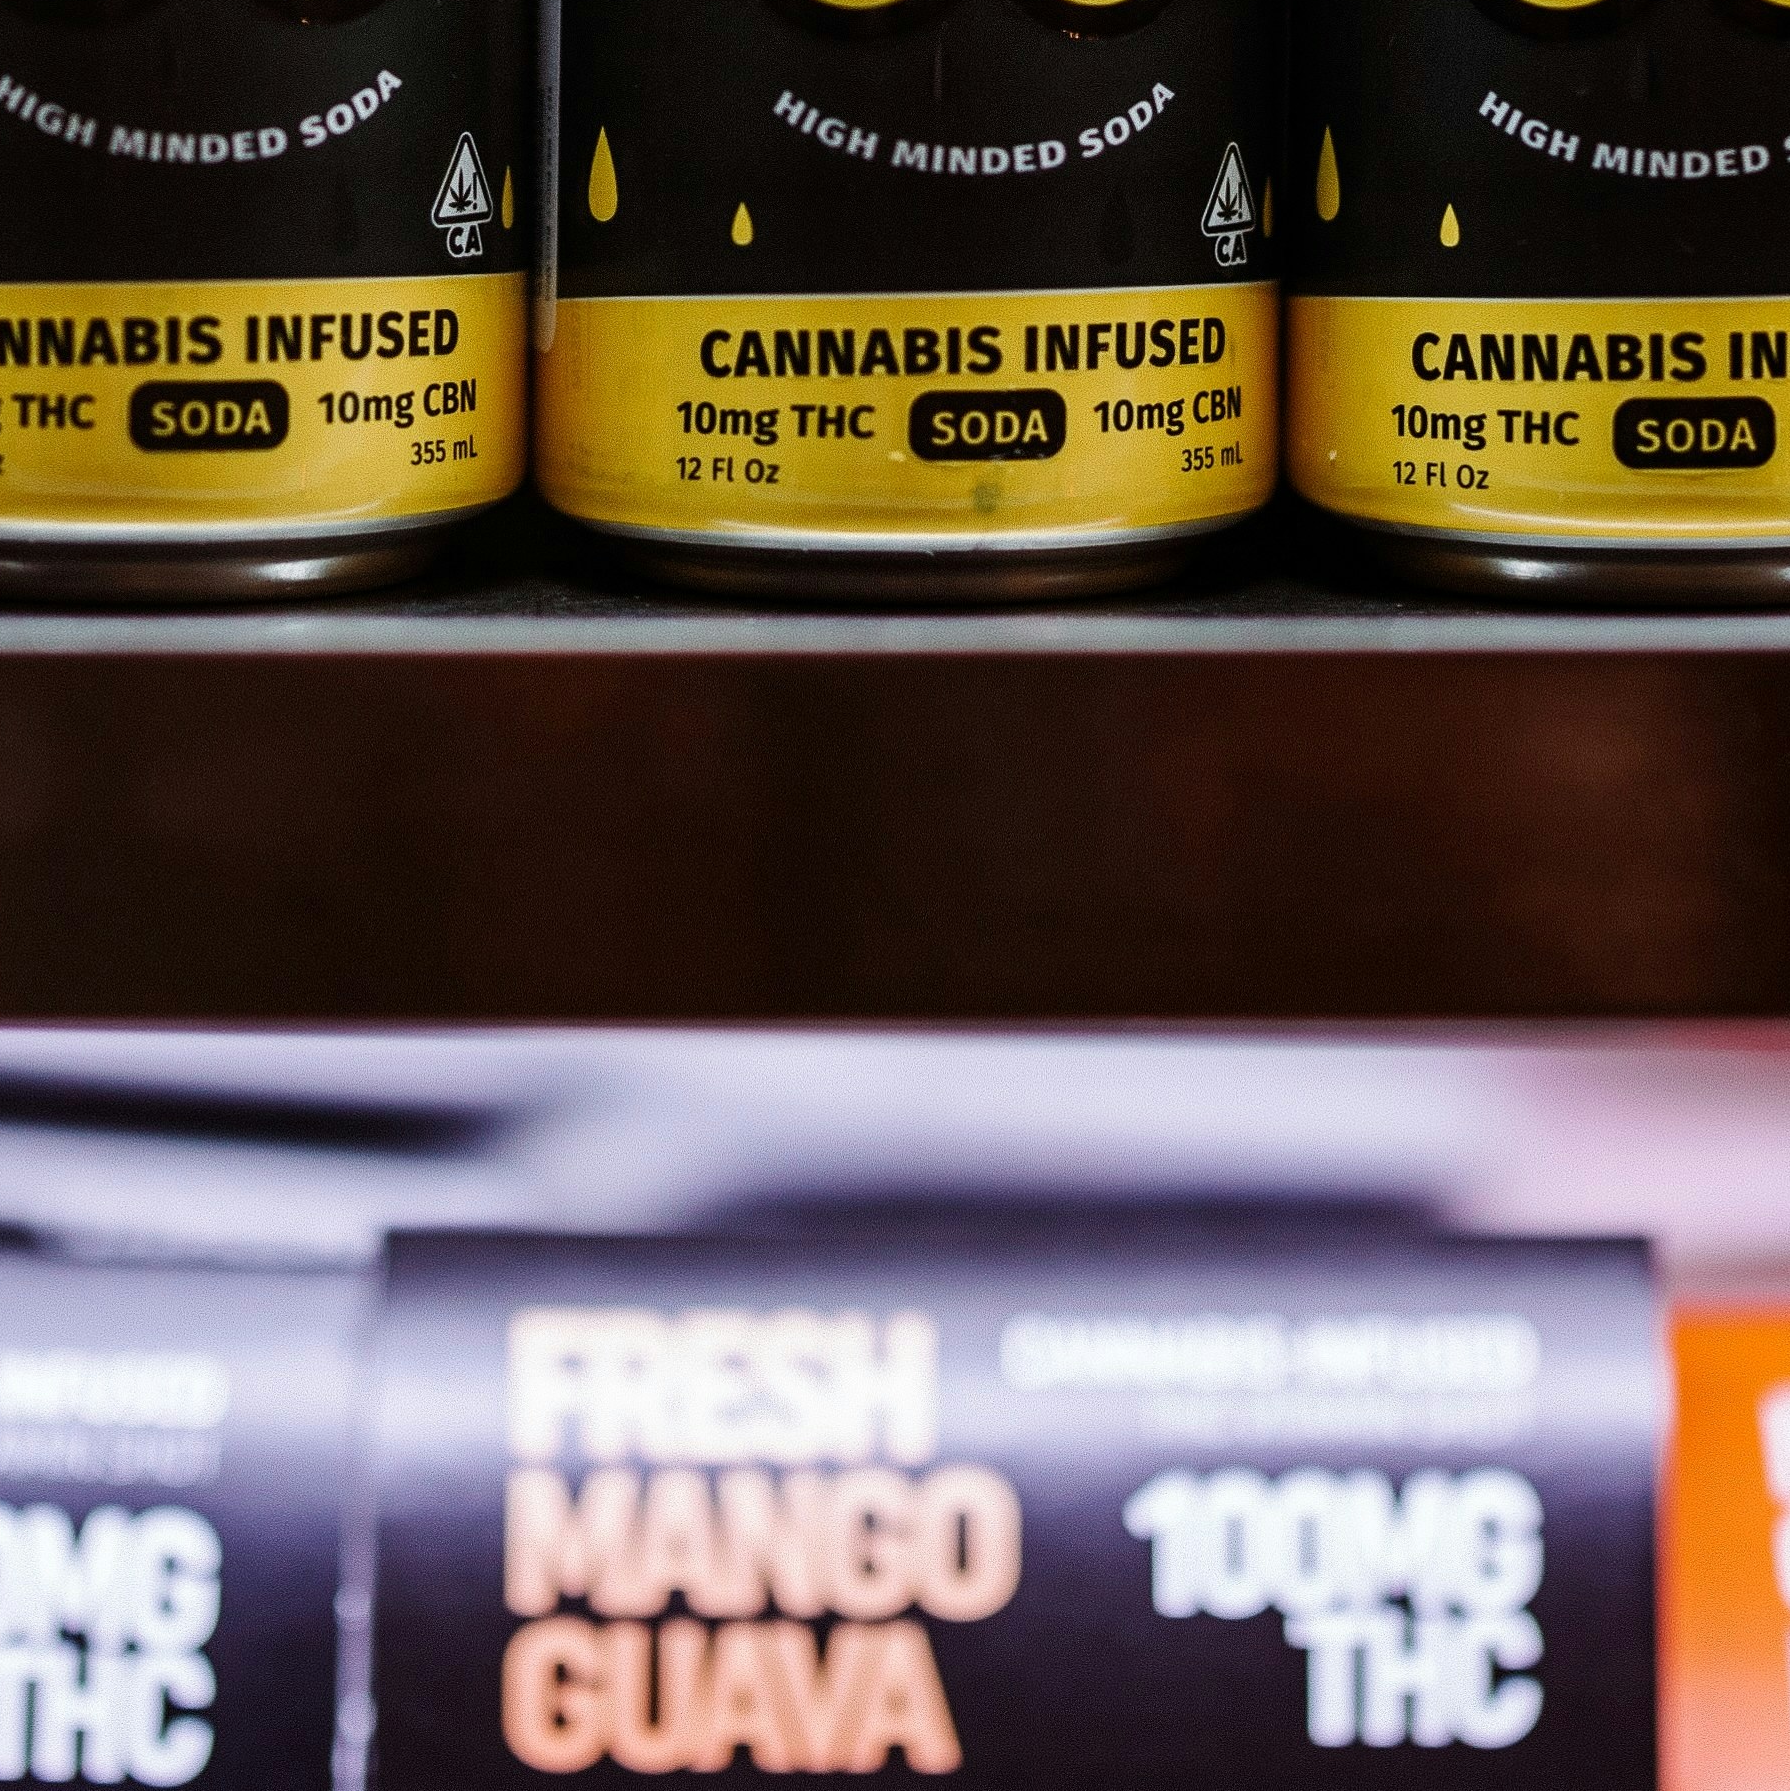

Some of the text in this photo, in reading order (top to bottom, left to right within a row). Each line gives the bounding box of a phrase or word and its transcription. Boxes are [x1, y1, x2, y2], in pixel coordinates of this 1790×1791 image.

[109, 124, 288, 164] MINDED
[299, 69, 403, 148] SODA
[772, 81, 1176, 176] HIGH MINDED SODA
[1478, 90, 1580, 162] HIGH
[1591, 142, 1771, 179] MINDED
[247, 308, 459, 363] INFUSED
[699, 317, 1226, 378] CANNABIS INFUSED
[1411, 332, 1708, 383] CANNABIS
[13, 394, 96, 430] THC
[151, 401, 271, 436] SODA
[318, 391, 415, 428] 10mg
[423, 378, 478, 419] CBN
[677, 385, 1243, 445] 10mg THC SODA 10mg CBN
[1392, 404, 1487, 451] 10mg
[1497, 409, 1580, 446] THC
[1636, 419, 1756, 453] SODA
[409, 435, 479, 466] 355 mL
[675, 456, 780, 483] 12 Fl Oz
[1181, 442, 1244, 473] 355 mL
[1393, 460, 1489, 490] 12 Fl Oz
[506, 1306, 940, 1465] FRESH
[503, 1461, 1024, 1623] MANGO
[1123, 1465, 1545, 1621] 100MG
[501, 1616, 963, 1775] GUAVA
[1285, 1605, 1545, 1750] THC
